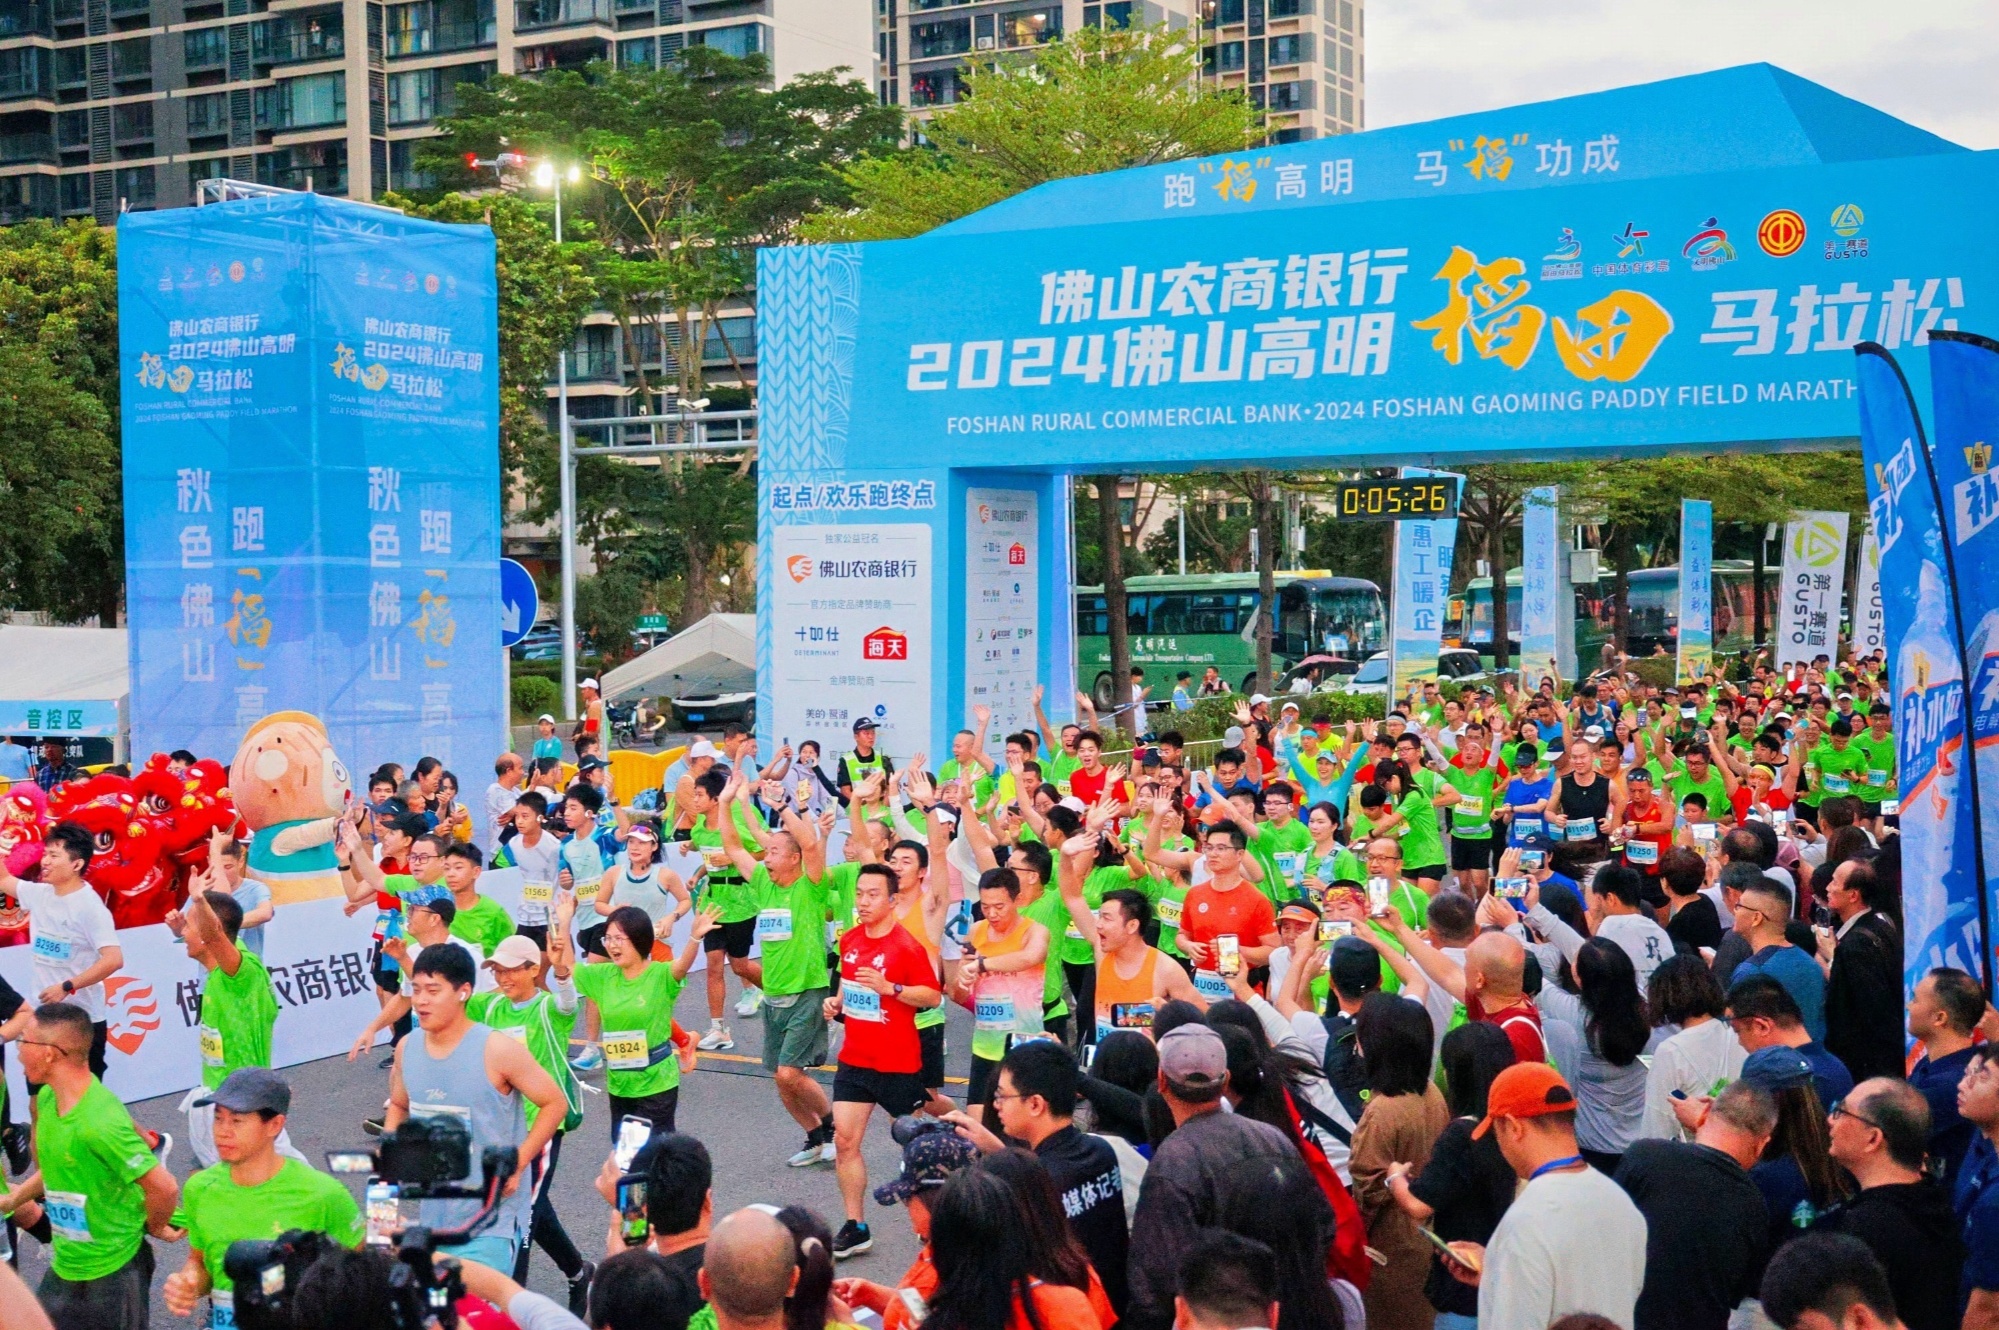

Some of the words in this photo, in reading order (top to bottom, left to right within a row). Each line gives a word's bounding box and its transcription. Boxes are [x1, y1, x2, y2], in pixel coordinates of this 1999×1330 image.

[1824, 250, 1868, 260] GUSTO
[1592, 259, 1669, 276] 中国体育彩票
[1040, 248, 1408, 325] 佛山农商银行
[169, 314, 259, 338] 佛山农商银行
[364, 317, 451, 344] 佛山农商银行
[907, 312, 1395, 391] 2024佛山高明
[1701, 277, 1965, 356] 马拉松
[168, 333, 296, 360] 2024佛山高明
[363, 341, 484, 372] 2024佛山高明
[197, 368, 253, 392] 马拉松
[390, 373, 443, 398] 马拉松
[946, 412, 1025, 435] FOSHAN
[1032, 410, 1096, 432] RURAL
[1103, 407, 1237, 429] COMMERCIAL
[1373, 397, 1463, 419] FOSHAN
[1471, 390, 1583, 414] GAOMING
[1593, 386, 1669, 410] PADDY
[1678, 384, 1748, 406] FIELD
[772, 482, 934, 508] 起点/欢乐跑终点
[1344, 485, 1445, 514] 0:05:26
[825, 533, 879, 544] 独家公益冠名
[176, 468, 216, 682] 秋色佛山
[368, 466, 401, 681] 秋色佛山
[819, 560, 917, 578] 佛山农商银行
[1412, 524, 1436, 631] 惠工暖企
[810, 599, 892, 610] 官方指定品牌赞助商
[1792, 573, 1811, 644] GUSTO
[1808, 573, 1831, 647] 第一赛道
[868, 638, 903, 657] 海天
[829, 676, 874, 686] 金牌赞助商
[27, 709, 83, 729] 音控区
[1567, 825, 1589, 833] B1100
[1628, 847, 1651, 855] B1250
[524, 887, 547, 897] C1565
[1194, 979, 1226, 992] BU005
[605, 1041, 640, 1055] C1824
